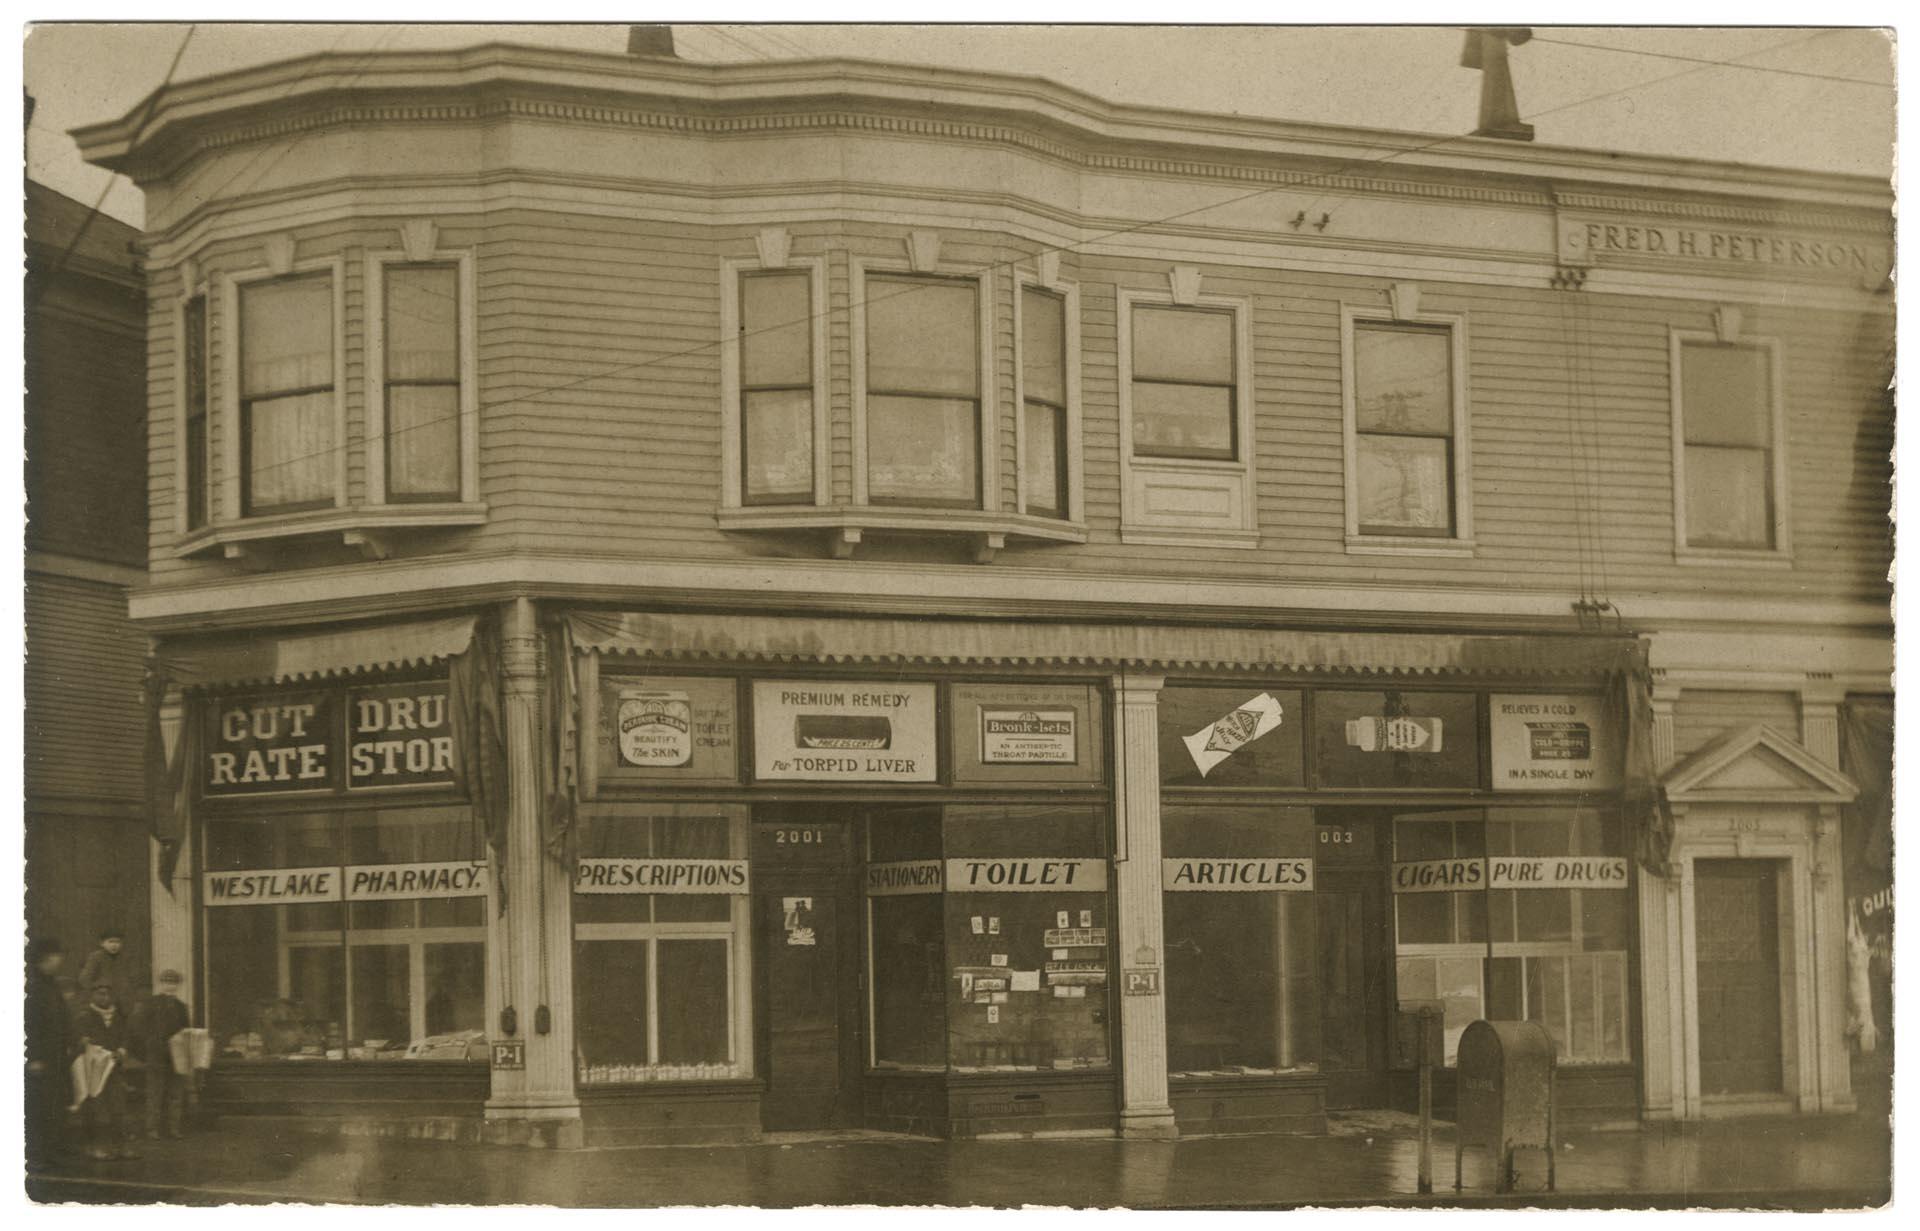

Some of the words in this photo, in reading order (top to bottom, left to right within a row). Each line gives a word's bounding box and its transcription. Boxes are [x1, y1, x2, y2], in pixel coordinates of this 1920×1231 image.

[1710, 233, 1866, 269] PETERSON
[782, 691, 845, 706] PREMIUM
[852, 693, 911, 708] REMEDY
[1501, 703, 1540, 714] RELIEVES
[1542, 704, 1549, 714] A
[1552, 704, 1577, 715] COLD
[223, 704, 315, 741] CUT
[634, 735, 678, 744] BEAUTIFY
[632, 747, 649, 758] The
[651, 748, 680, 758] SKIN
[992, 751, 1026, 759] THROAT
[210, 744, 326, 784] RATE
[771, 759, 791, 772] For
[792, 758, 859, 773] TORPID
[866, 759, 916, 773] LIVER
[1509, 769, 1519, 779] IN
[1521, 769, 1528, 779] A
[1531, 769, 1568, 779] SINGLE
[1574, 769, 1595, 779] DAY
[776, 831, 822, 843] 2001
[351, 866, 482, 893] PHARMACY.
[576, 864, 746, 887] PRESCRIPTIONS
[869, 865, 942, 888] STATIONERY
[966, 862, 1081, 885] TOILET
[1173, 862, 1308, 884] ARTICLES
[1396, 862, 1482, 887] CIGARS
[1493, 862, 1545, 881] PURE
[1555, 862, 1626, 881] DRUGS
[210, 873, 330, 898] WESTLAKE
